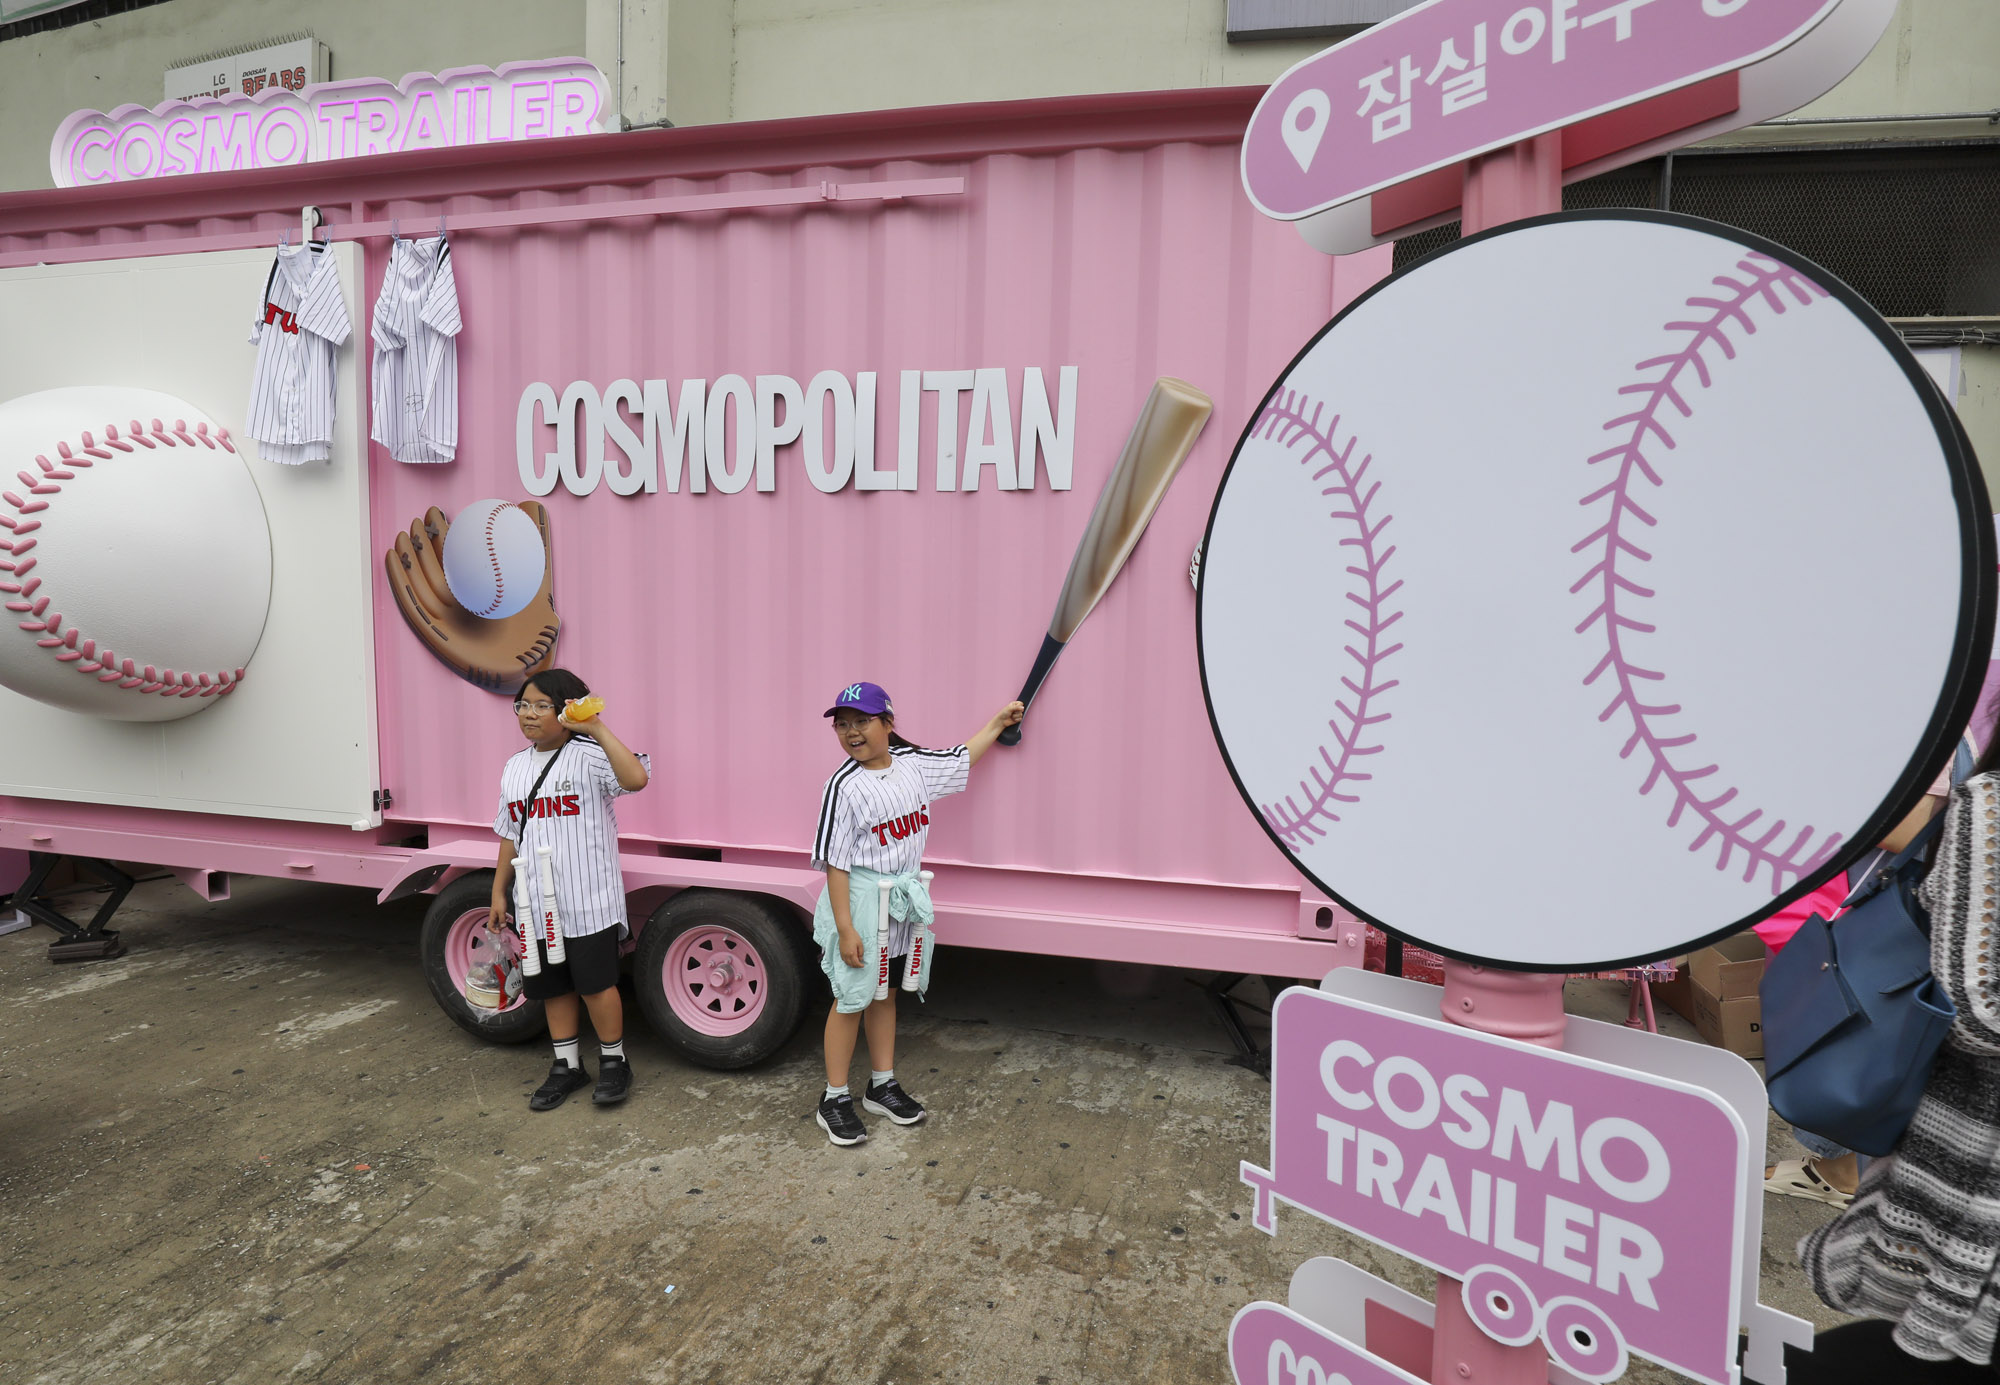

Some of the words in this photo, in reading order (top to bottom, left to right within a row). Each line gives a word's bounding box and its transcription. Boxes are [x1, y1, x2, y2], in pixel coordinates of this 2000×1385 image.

[213, 73, 226, 87] LG
[242, 67, 268, 78] DOOSAN
[242, 66, 306, 97] BEARS
[69, 106, 309, 188] COSMO
[318, 77, 600, 161] TRAILER
[515, 365, 1079, 497] COSMOPOLITAN
[554, 780, 572, 792] LG
[507, 794, 580, 823] TWINS
[545, 911, 557, 950] TWINS
[878, 946, 888, 987] TWINS
[910, 936, 923, 977] TWINS
[1319, 1039, 1671, 1203] COSMO
[1316, 1112, 1664, 1312] TRAILER
